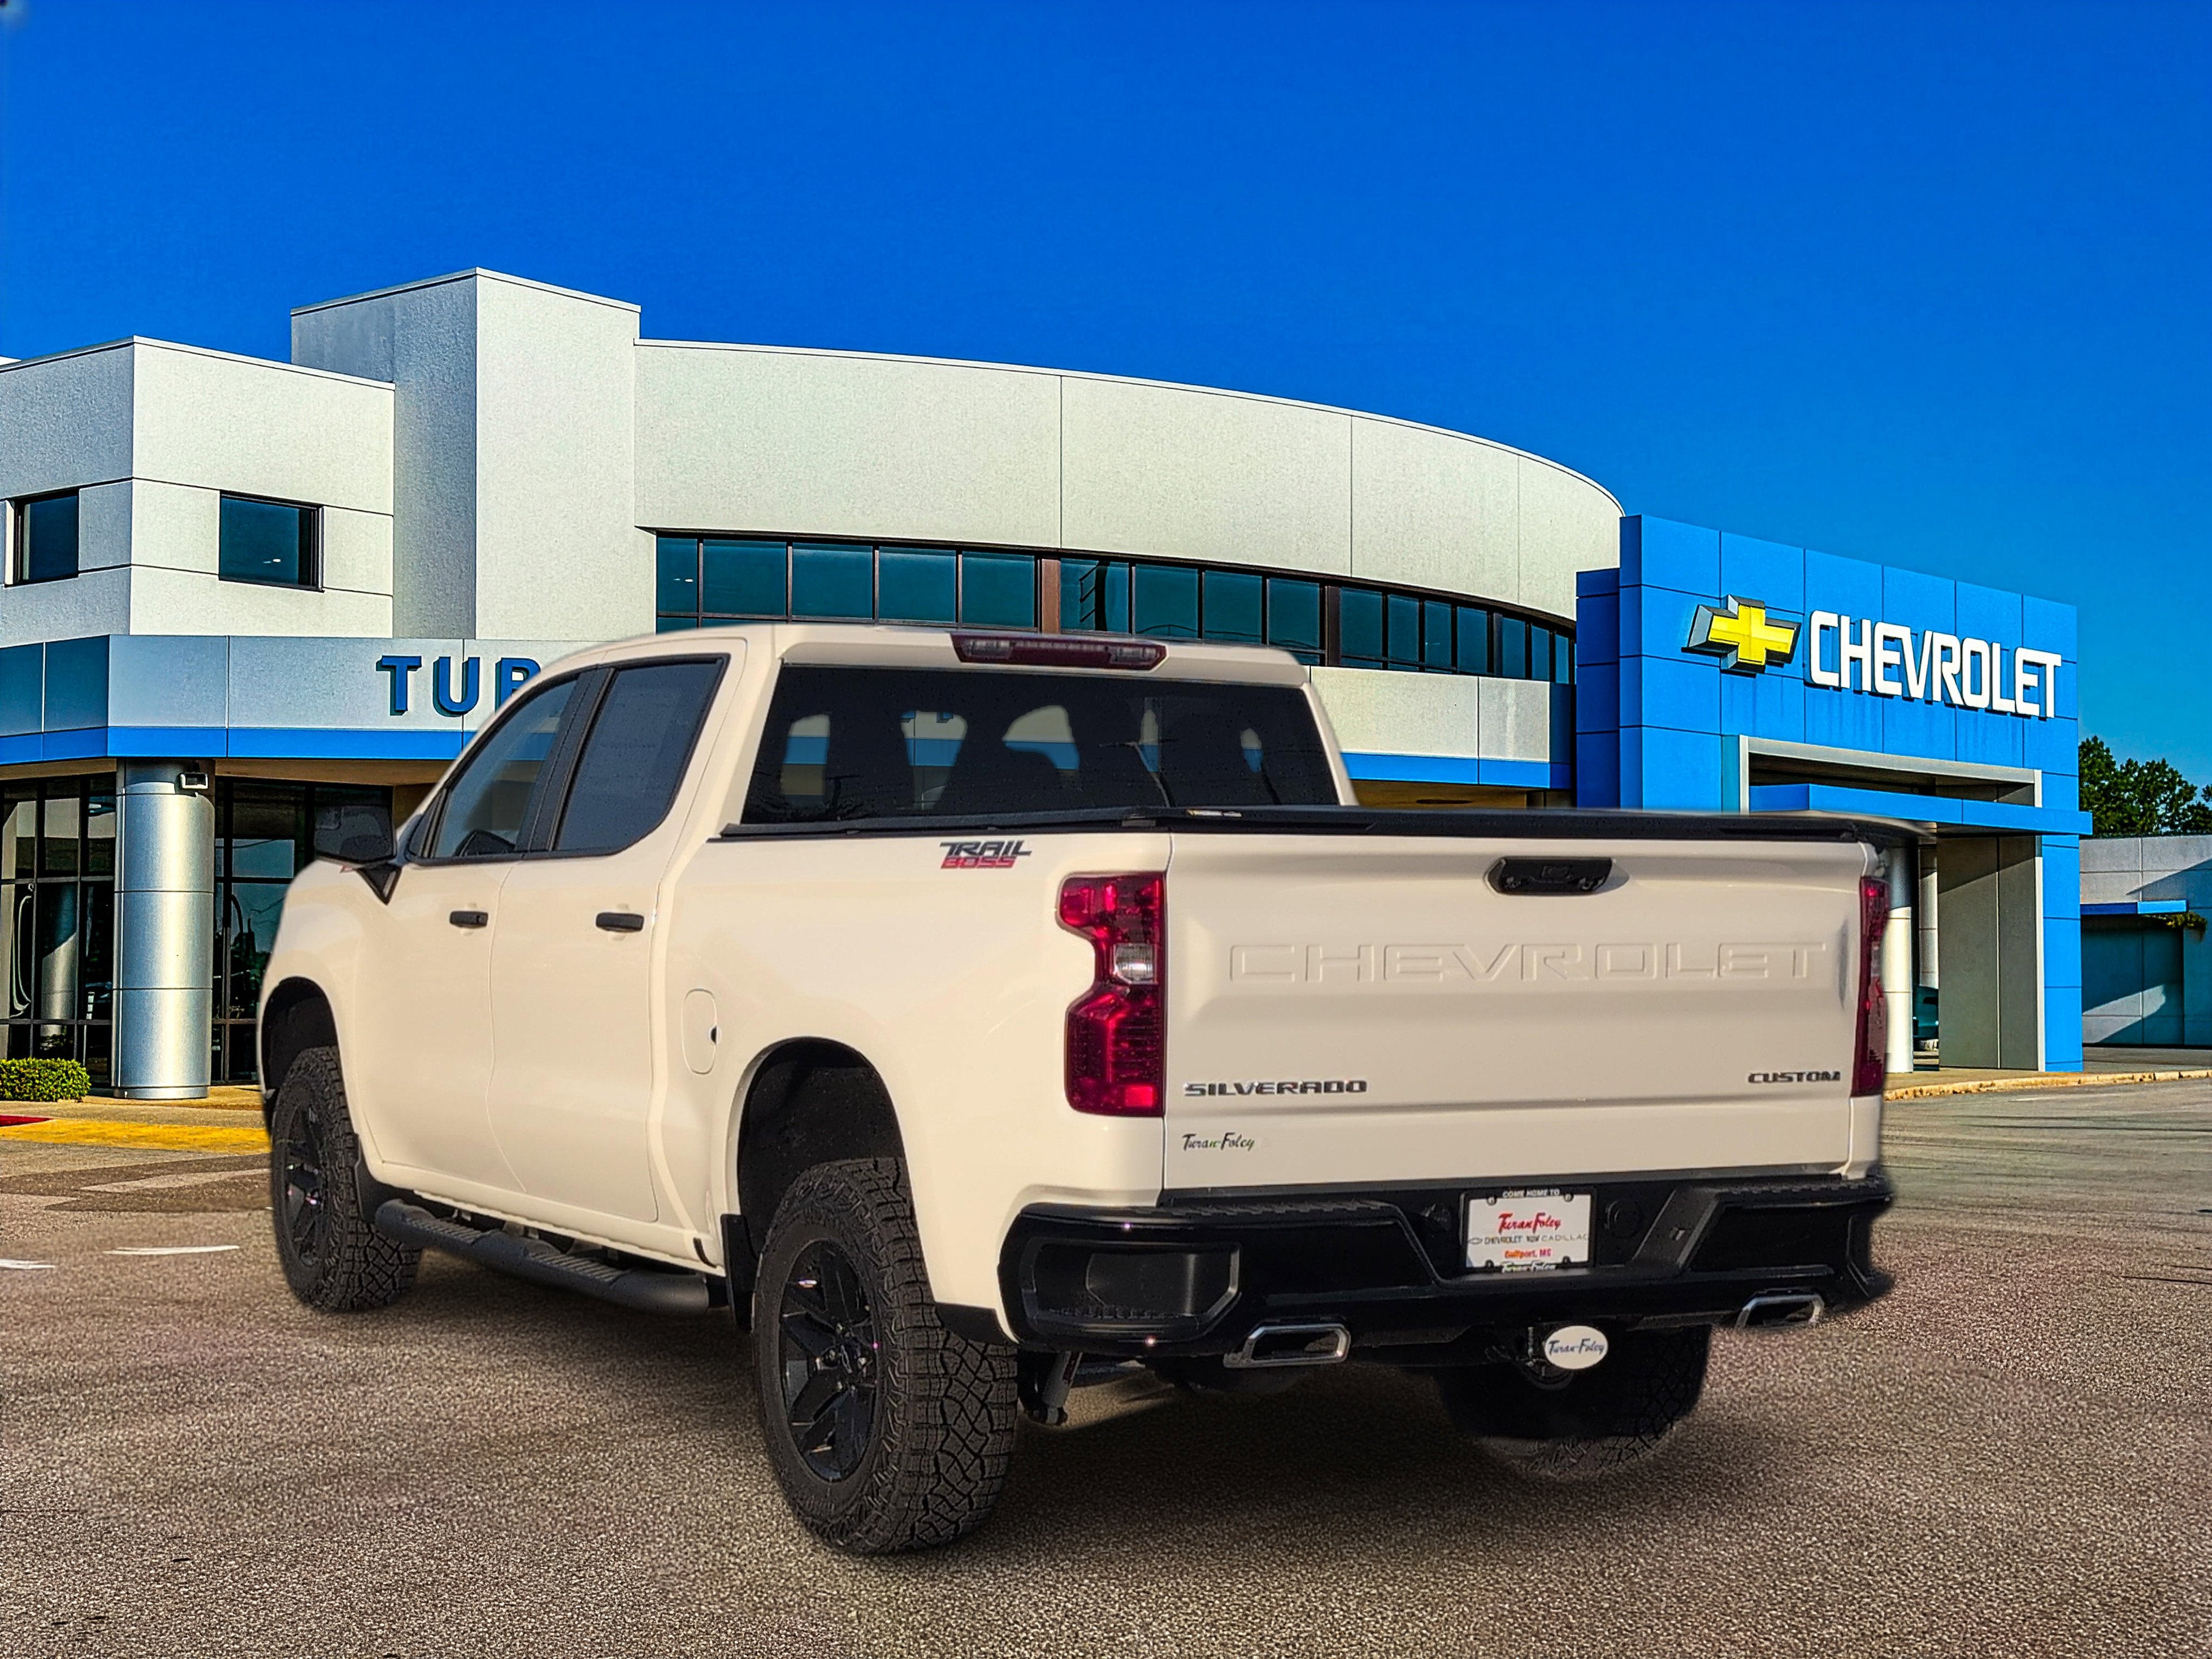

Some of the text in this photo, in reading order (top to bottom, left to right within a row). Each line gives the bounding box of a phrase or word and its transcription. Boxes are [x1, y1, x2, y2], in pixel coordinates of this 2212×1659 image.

[1810, 610, 2062, 718] CHEVROLET
[940, 840, 1032, 857] TRAIL
[941, 855, 1017, 869] BOSS
[1230, 942, 1825, 982] CHEVROLET
[1748, 1071, 1840, 1083] CUSTOM
[1185, 1080, 1367, 1096] SILVERADO
